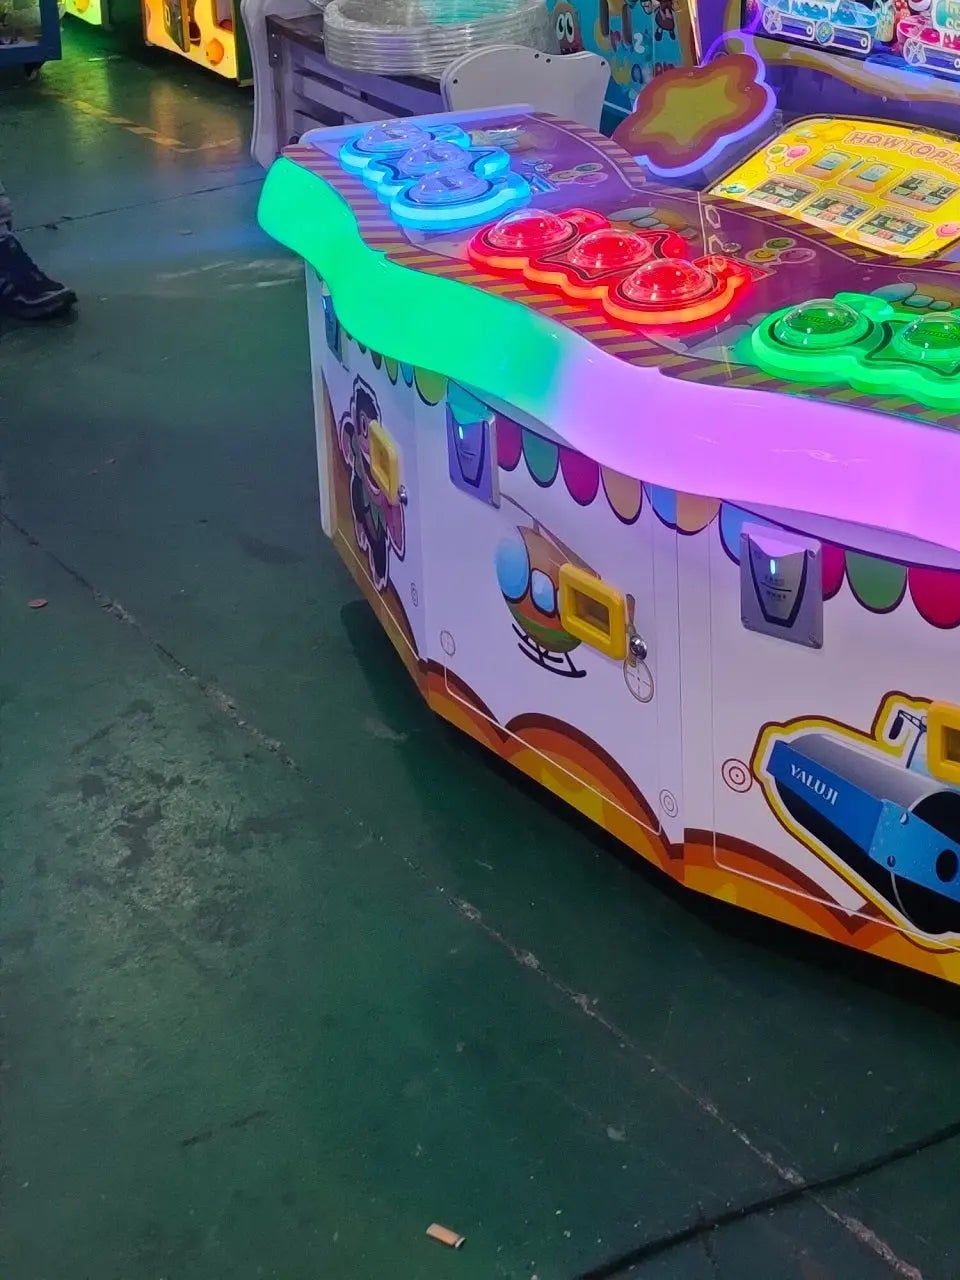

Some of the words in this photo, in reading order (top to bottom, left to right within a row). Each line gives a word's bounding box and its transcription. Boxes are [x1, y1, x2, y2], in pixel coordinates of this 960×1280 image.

[843, 131, 904, 153] HOW
[903, 140, 934, 158] TO
[788, 763, 840, 807] YALUJI
